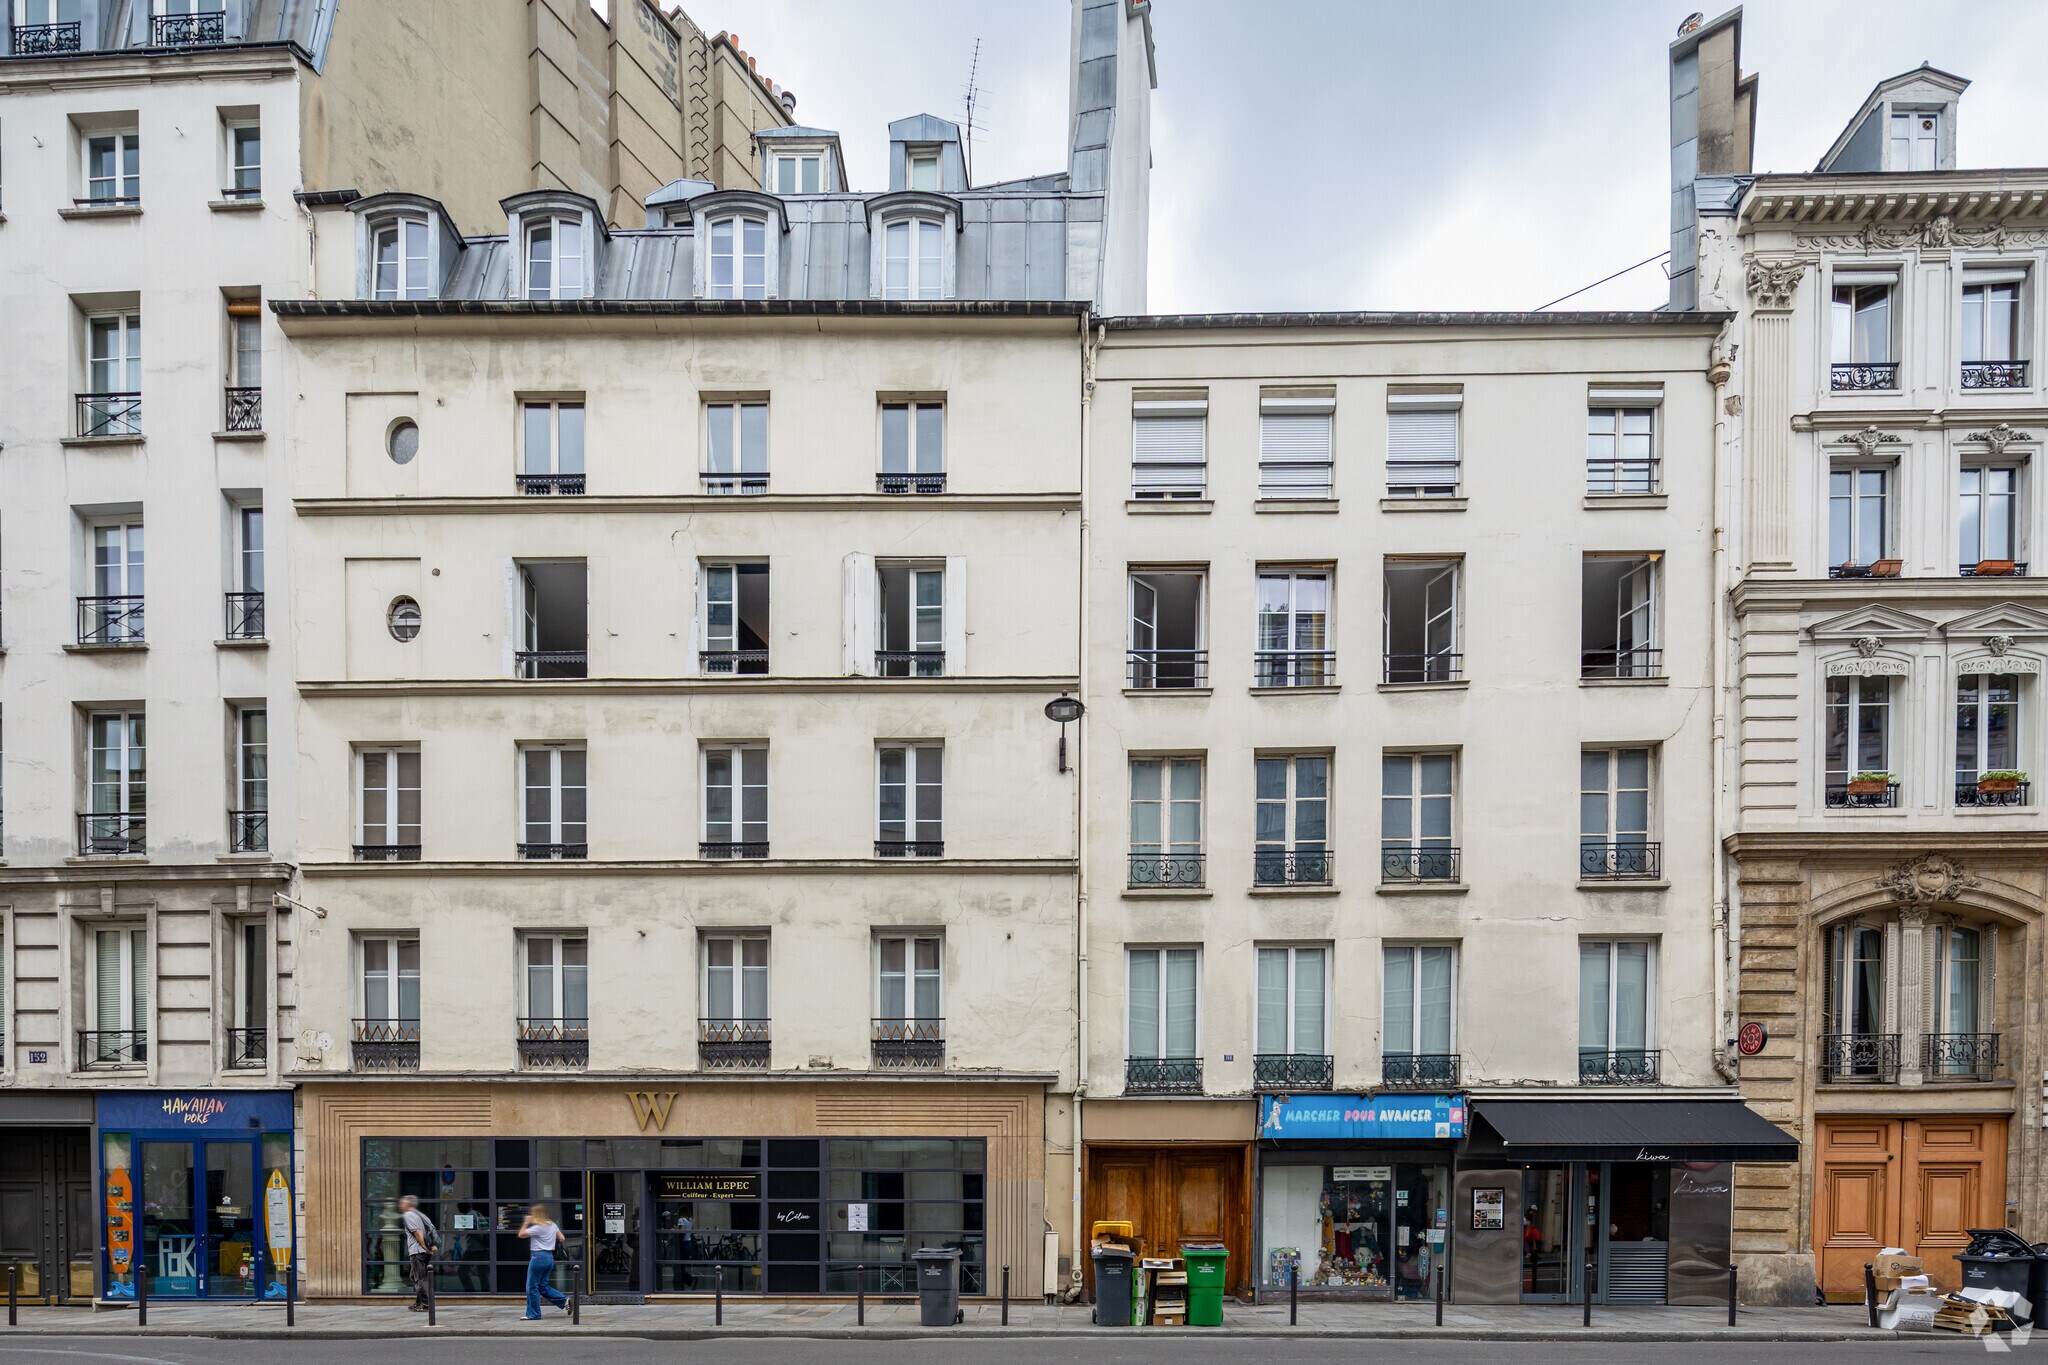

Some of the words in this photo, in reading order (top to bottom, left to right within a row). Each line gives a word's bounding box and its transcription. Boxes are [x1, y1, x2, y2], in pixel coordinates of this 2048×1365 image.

[30, 1052, 46, 1062] 152
[162, 1096, 227, 1115] HAWAIIAN
[626, 1091, 678, 1131] W
[1285, 1109, 1340, 1122] MARCHER
[1344, 1109, 1376, 1122] POUR
[1379, 1109, 1432, 1122] AVANCER
[1636, 1148, 1670, 1160] kiwa
[666, 1181, 713, 1190] WILLIAM
[716, 1181, 750, 1190] LEPEC
[1673, 1172, 1728, 1194] kiwa
